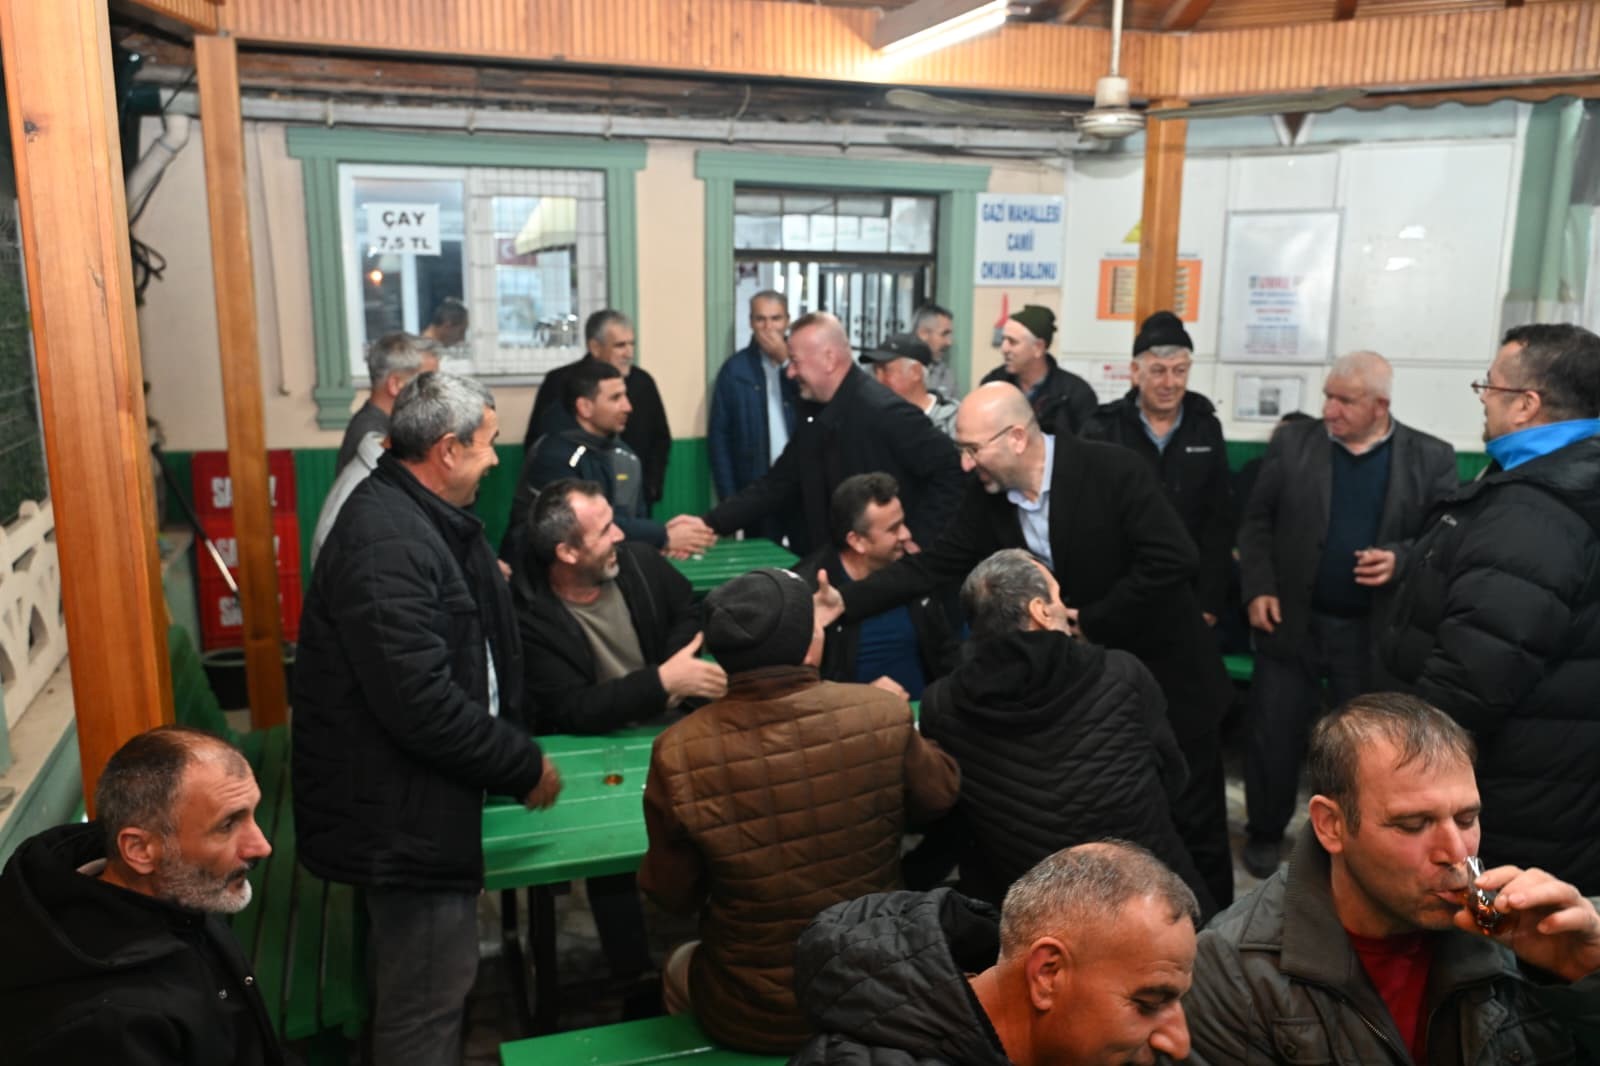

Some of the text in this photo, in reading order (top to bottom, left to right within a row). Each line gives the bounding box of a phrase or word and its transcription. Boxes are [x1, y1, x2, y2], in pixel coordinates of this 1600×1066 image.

[382, 211, 425, 228] ÇAY
[410, 236, 431, 250] TL
[981, 261, 1057, 280] OKUMA SALONU
